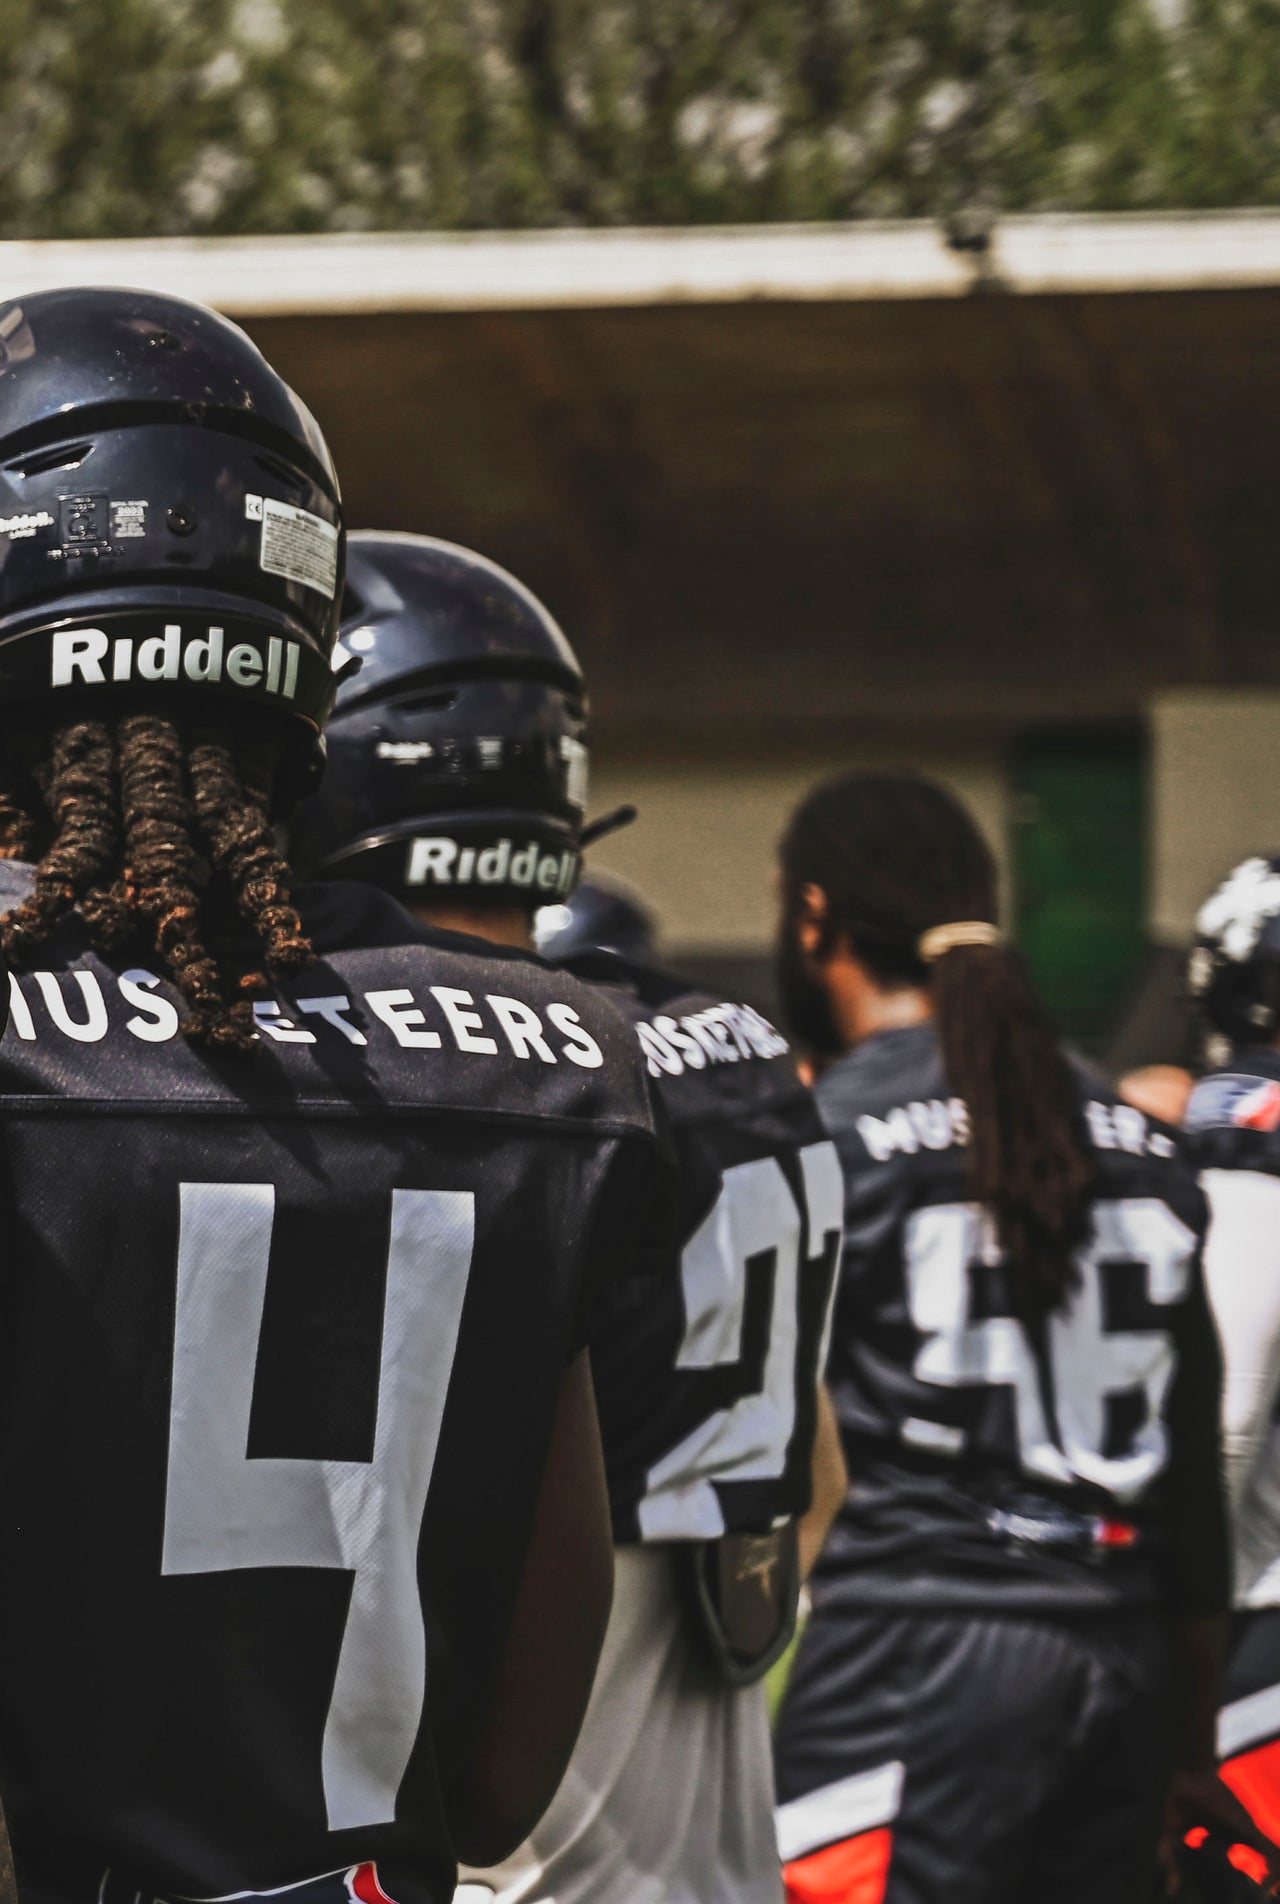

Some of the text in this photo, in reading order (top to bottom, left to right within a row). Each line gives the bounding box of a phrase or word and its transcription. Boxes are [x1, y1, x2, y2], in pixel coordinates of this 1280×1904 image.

[51, 624, 300, 699] Riddell
[406, 836, 577, 893] Riddell
[7, 970, 604, 1070] USETEERS
[160, 1182, 475, 1832] 4
